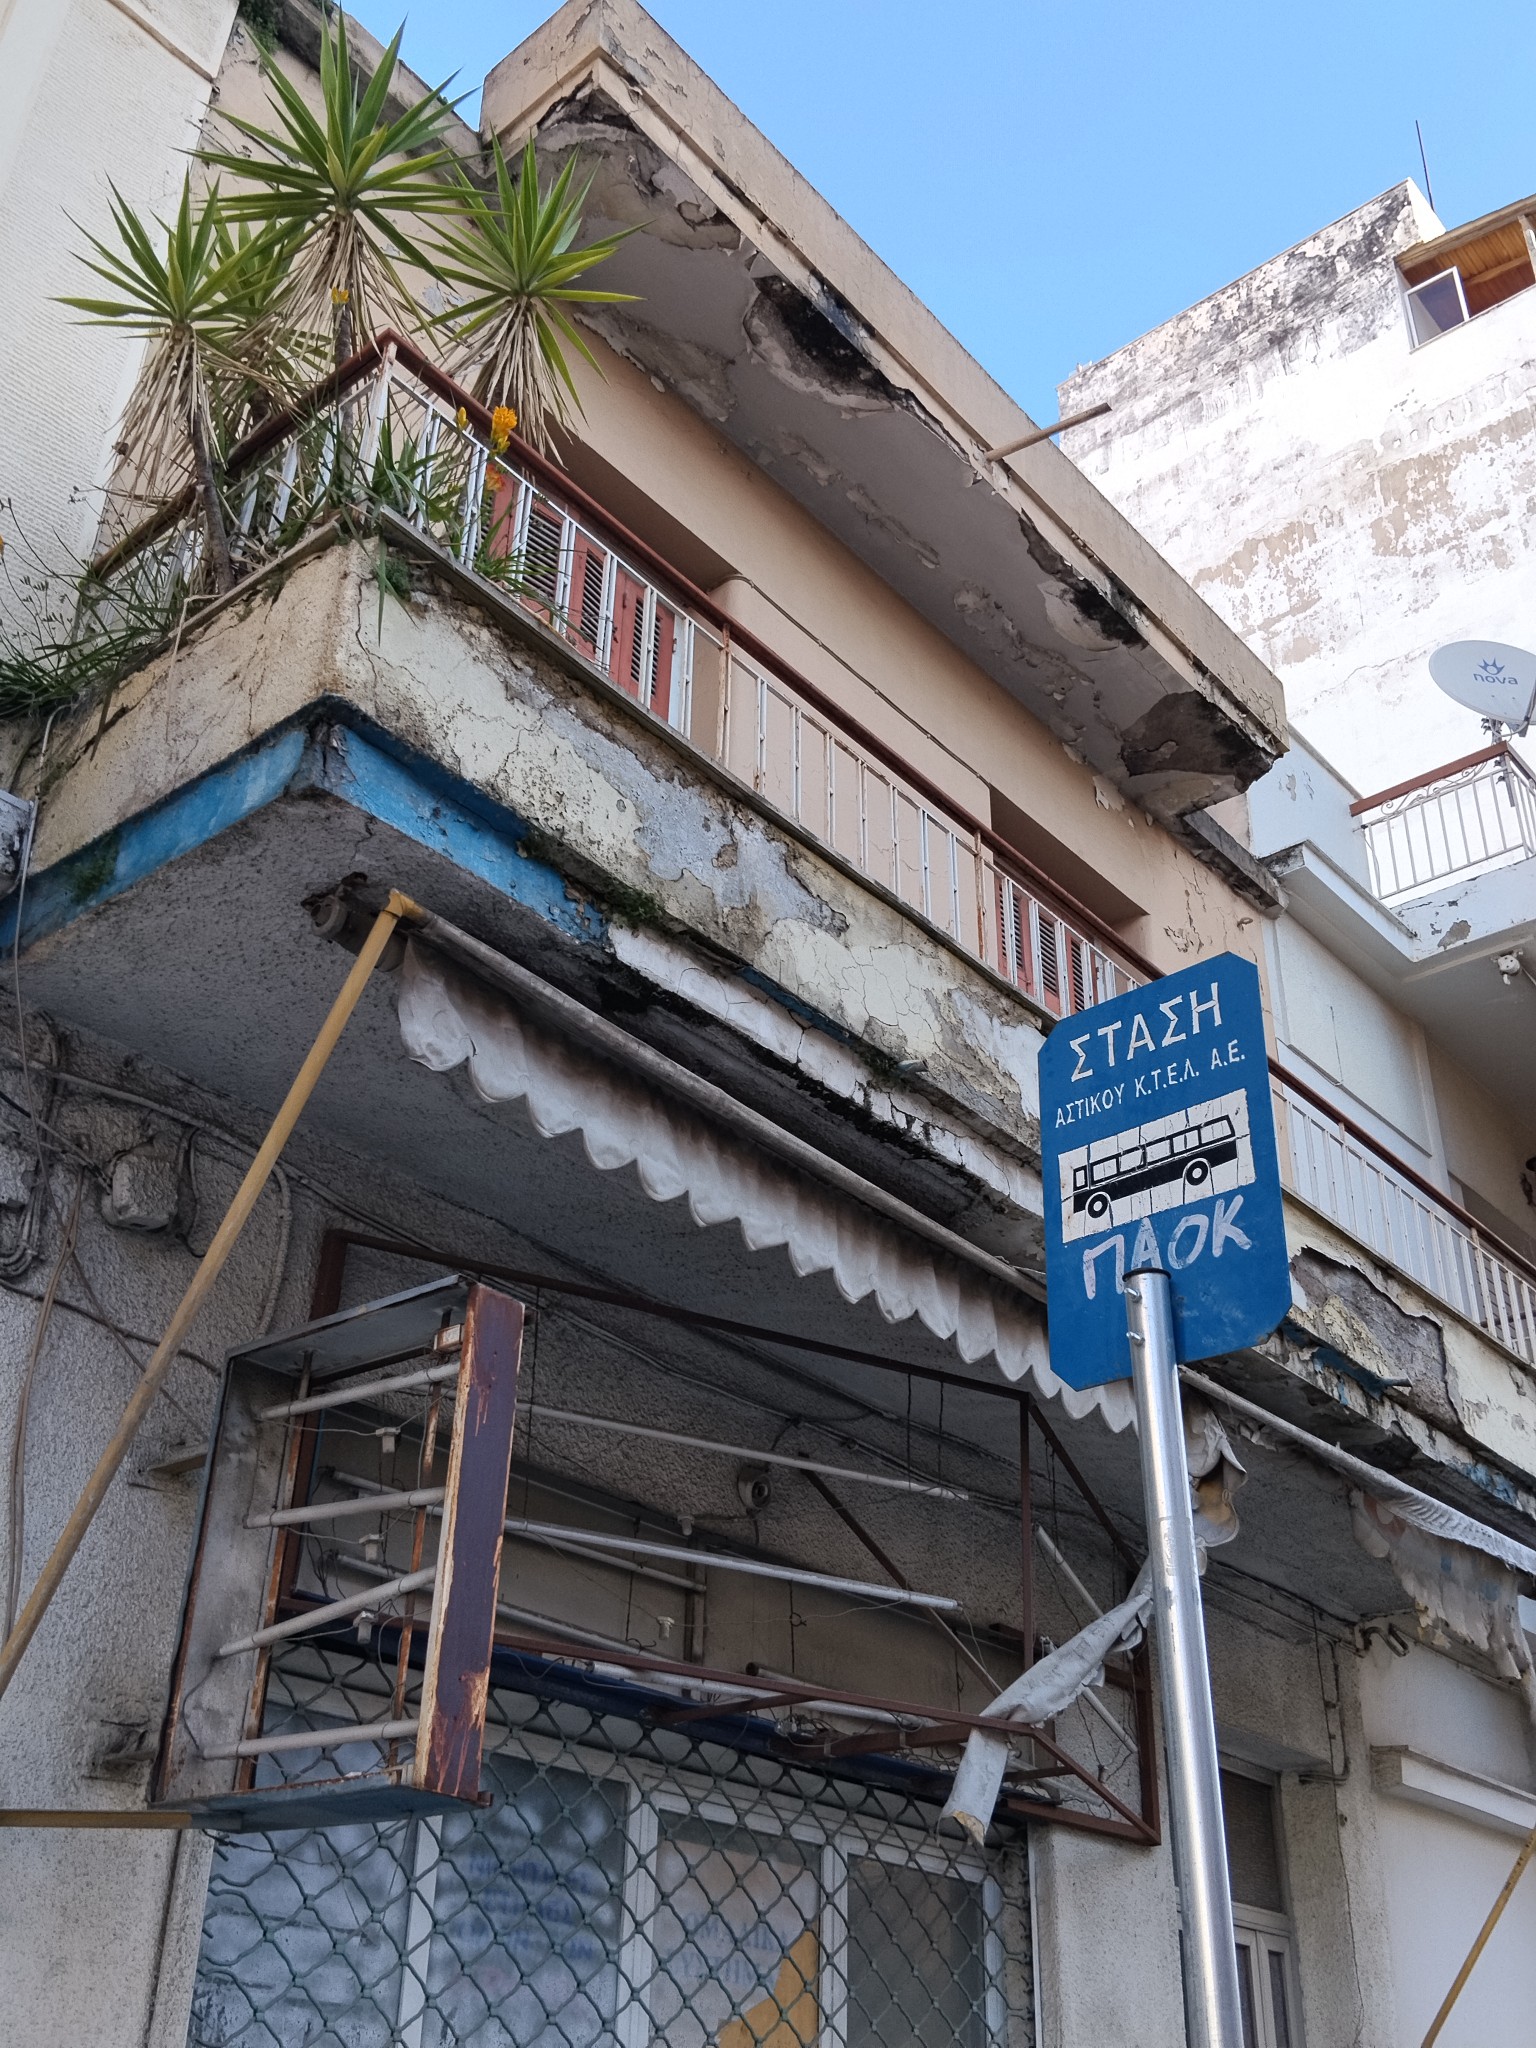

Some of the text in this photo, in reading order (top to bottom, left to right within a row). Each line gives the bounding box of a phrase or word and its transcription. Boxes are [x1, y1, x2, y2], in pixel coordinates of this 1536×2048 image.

[1473, 673, 1518, 685] nova
[1070, 982, 1222, 1082] ΣΤΑΣΗ
[1055, 1039, 1246, 1129] ΑΣΤΙΚΟΥ Κ.Τ.Ε.Λ. Α.Ε.
[1082, 1194, 1251, 1299] ΠΑΟΚ
